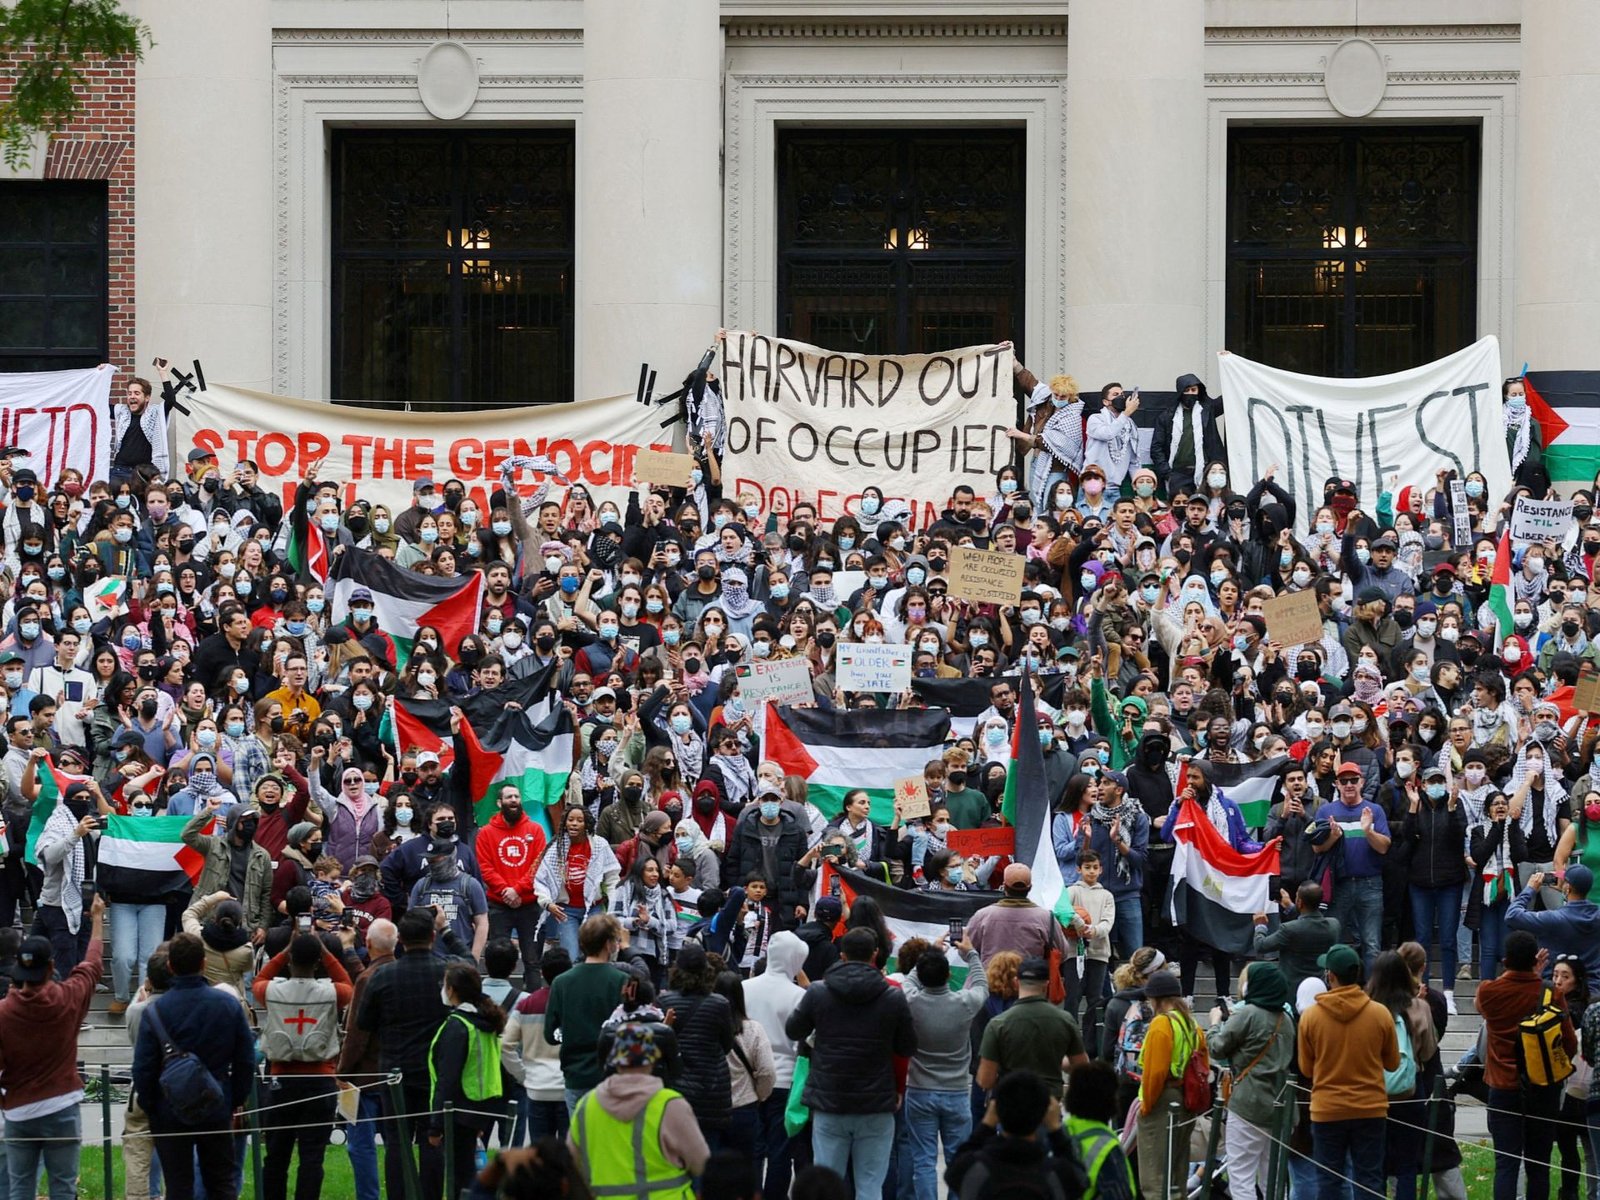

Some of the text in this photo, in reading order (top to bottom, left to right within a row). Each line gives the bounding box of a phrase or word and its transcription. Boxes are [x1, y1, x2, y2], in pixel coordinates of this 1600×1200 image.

[722, 331, 1013, 408] HARVARD OUT
[728, 416, 1016, 475] OF OCCUPIED
[185, 429, 672, 488] STOP THE GENOCID
[1247, 383, 1489, 524] DIVEST
[1516, 498, 1573, 517] RESISTANCE
[988, 554, 1015, 568] PEOPLE
[962, 563, 1017, 578] ARE OCCUPIED
[960, 574, 1005, 587] RESISTANCE
[962, 587, 1017, 601] IS JUSTIFIED
[854, 657, 892, 669] OLDER
[768, 673, 782, 684] IS
